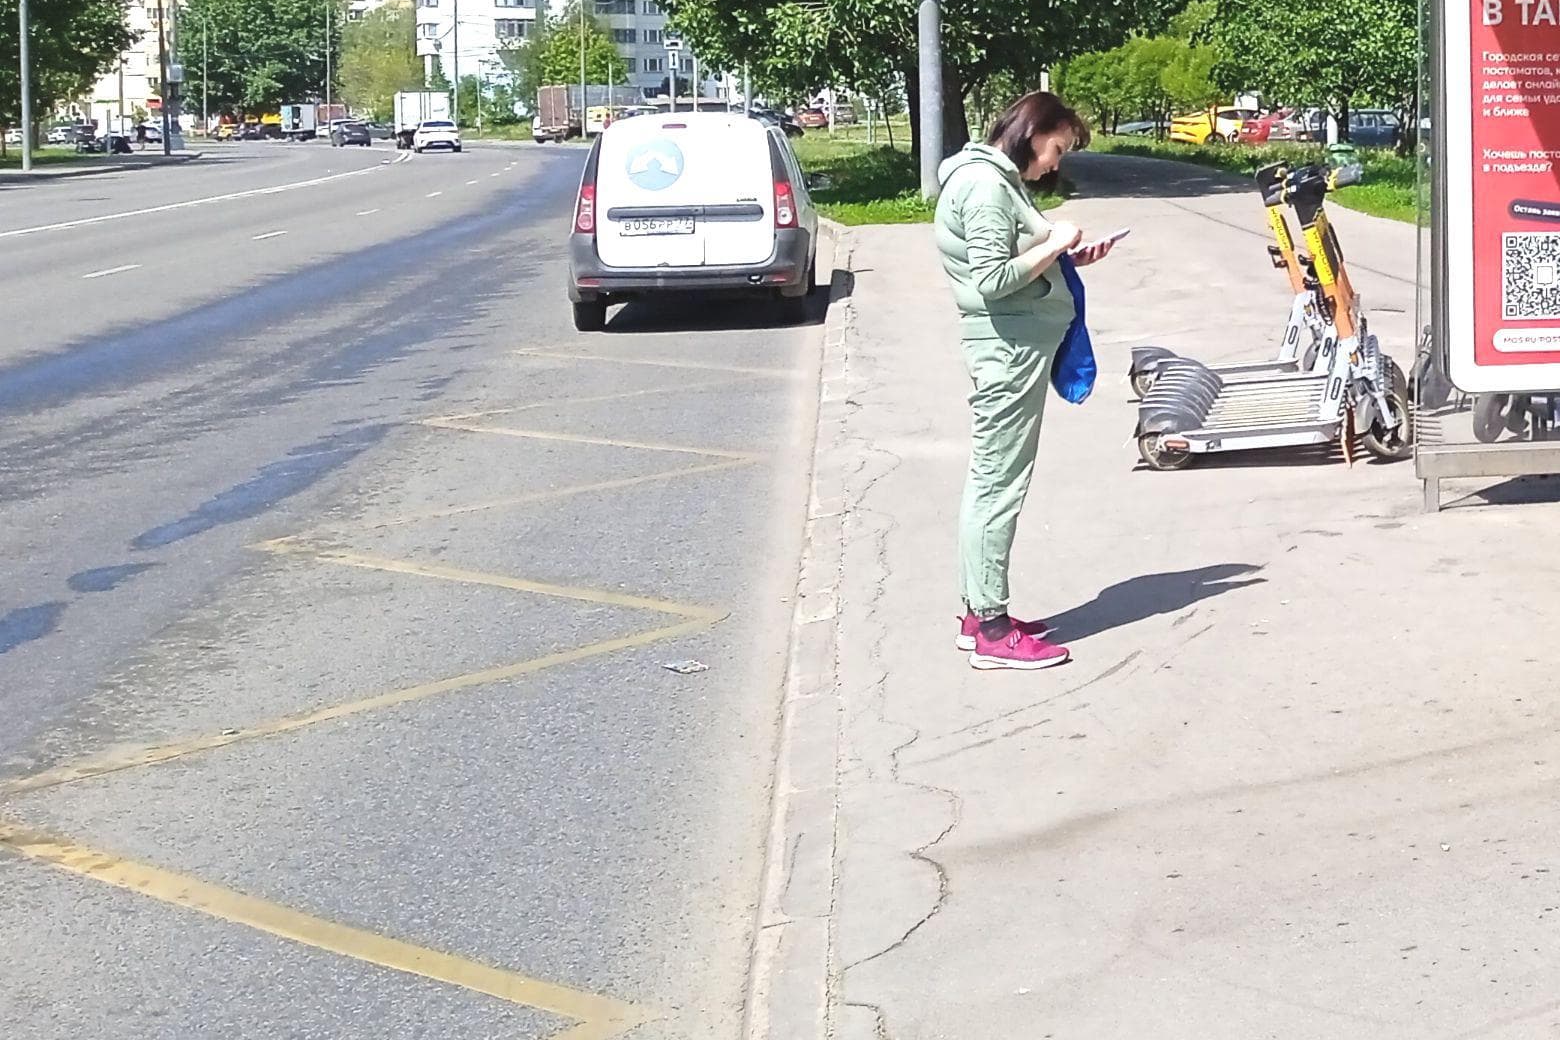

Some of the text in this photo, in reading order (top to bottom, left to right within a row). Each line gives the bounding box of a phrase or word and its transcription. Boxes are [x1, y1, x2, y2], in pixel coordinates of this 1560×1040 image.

[1482, 51, 1543, 64] Городская
[1482, 67, 1553, 76] постаматов,
[1482, 81, 1522, 90] делает
[1482, 95, 1503, 104] для
[1505, 94, 1540, 103] семьи
[1482, 106, 1529, 117] и ближе
[1482, 149, 1527, 159] Хочешь
[1482, 162, 1553, 173] в подъезде?
